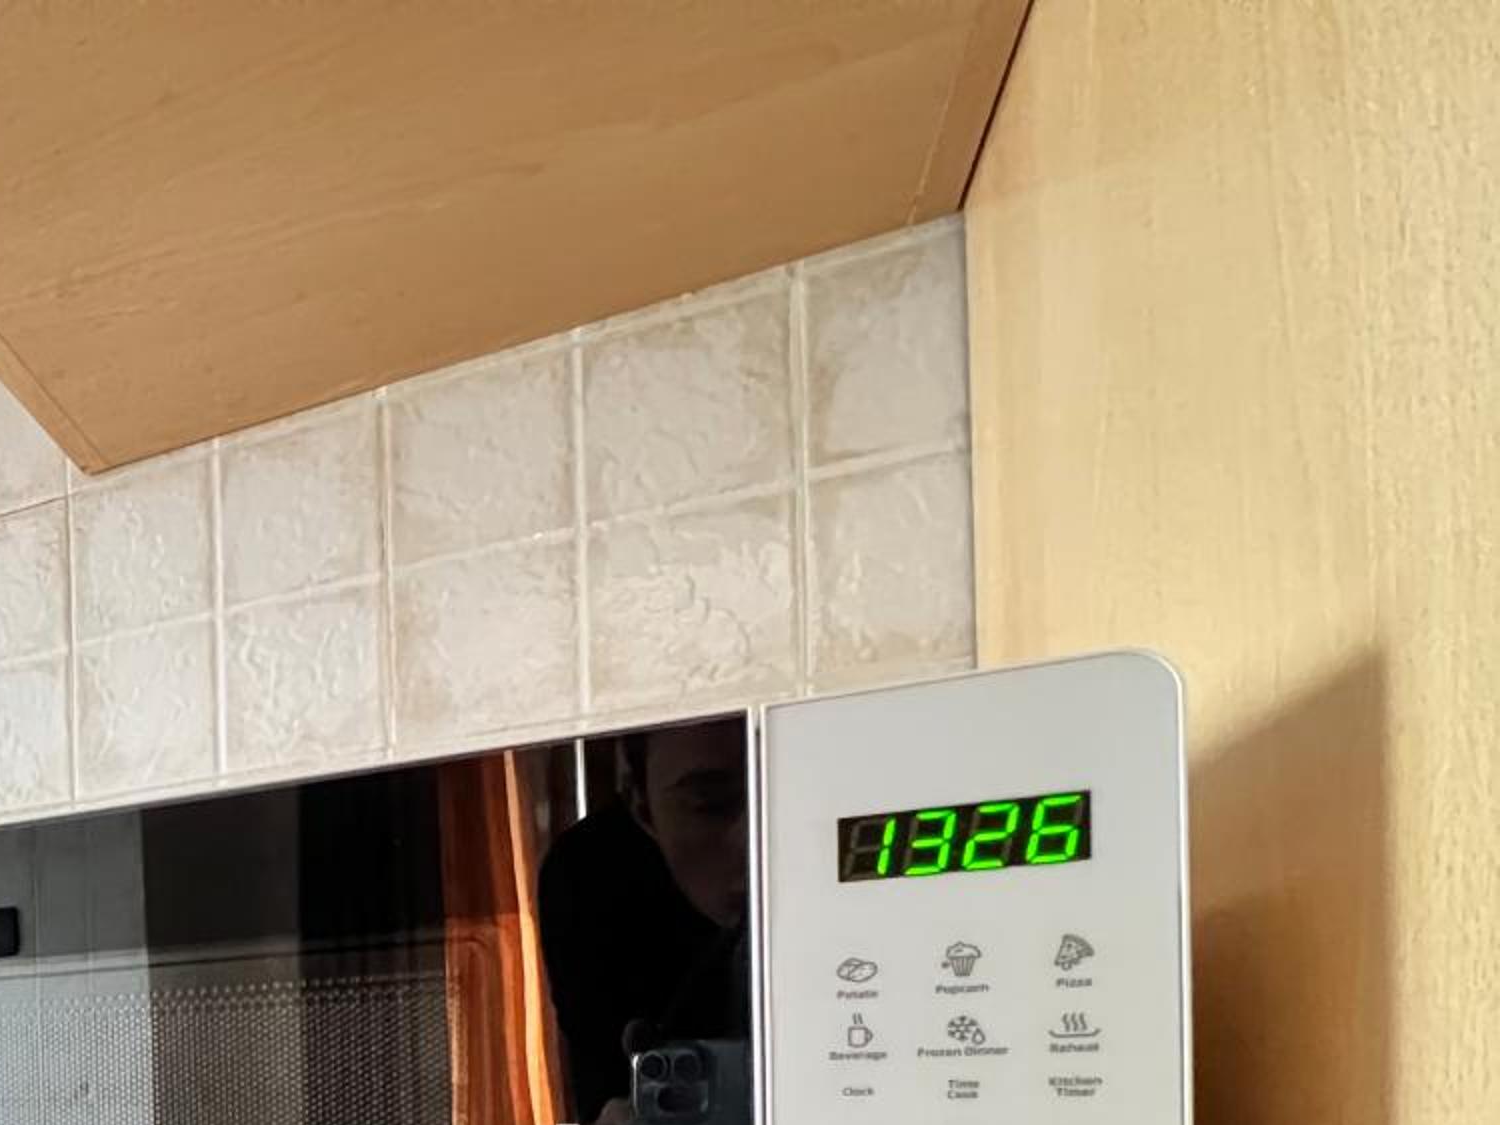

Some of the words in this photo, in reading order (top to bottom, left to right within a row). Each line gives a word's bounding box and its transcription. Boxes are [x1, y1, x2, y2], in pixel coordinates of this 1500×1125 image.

[877, 795, 1081, 876] 1326
[1055, 978, 1092, 988] Pizza
[935, 984, 990, 995] Popcorn
[917, 1047, 962, 1057] Frozen
[1049, 1042, 1100, 1053] Reheat
[829, 1051, 888, 1061] Beverage
